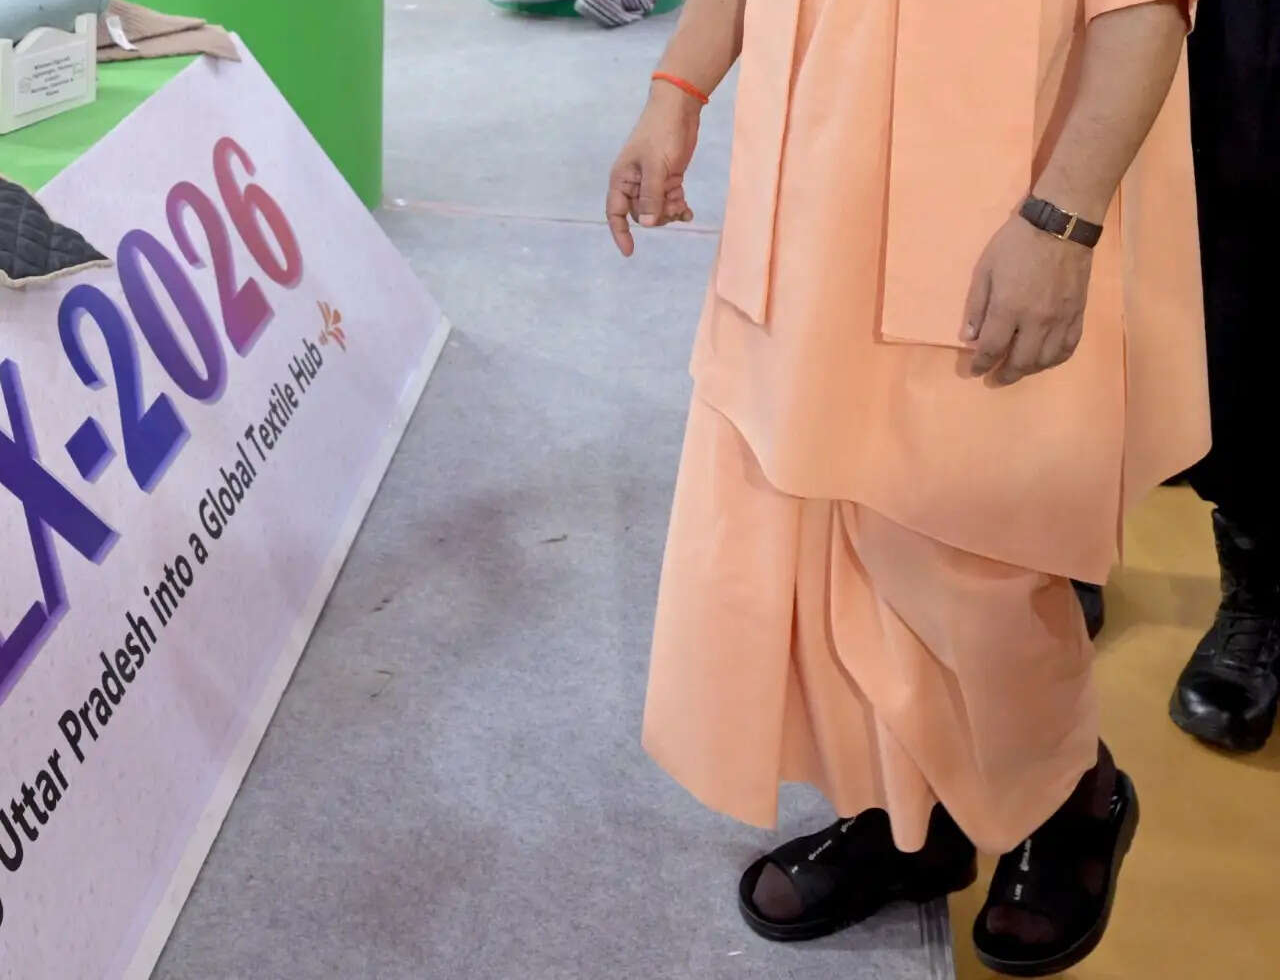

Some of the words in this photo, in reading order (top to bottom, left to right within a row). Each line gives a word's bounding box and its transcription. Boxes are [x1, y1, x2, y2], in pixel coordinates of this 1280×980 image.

[58, 611, 158, 763] Pradesh
[144, 553, 194, 628] into
[188, 532, 209, 566] a
[199, 441, 258, 540] Global
[245, 382, 299, 462] Textile
[288, 338, 323, 394] Hub
